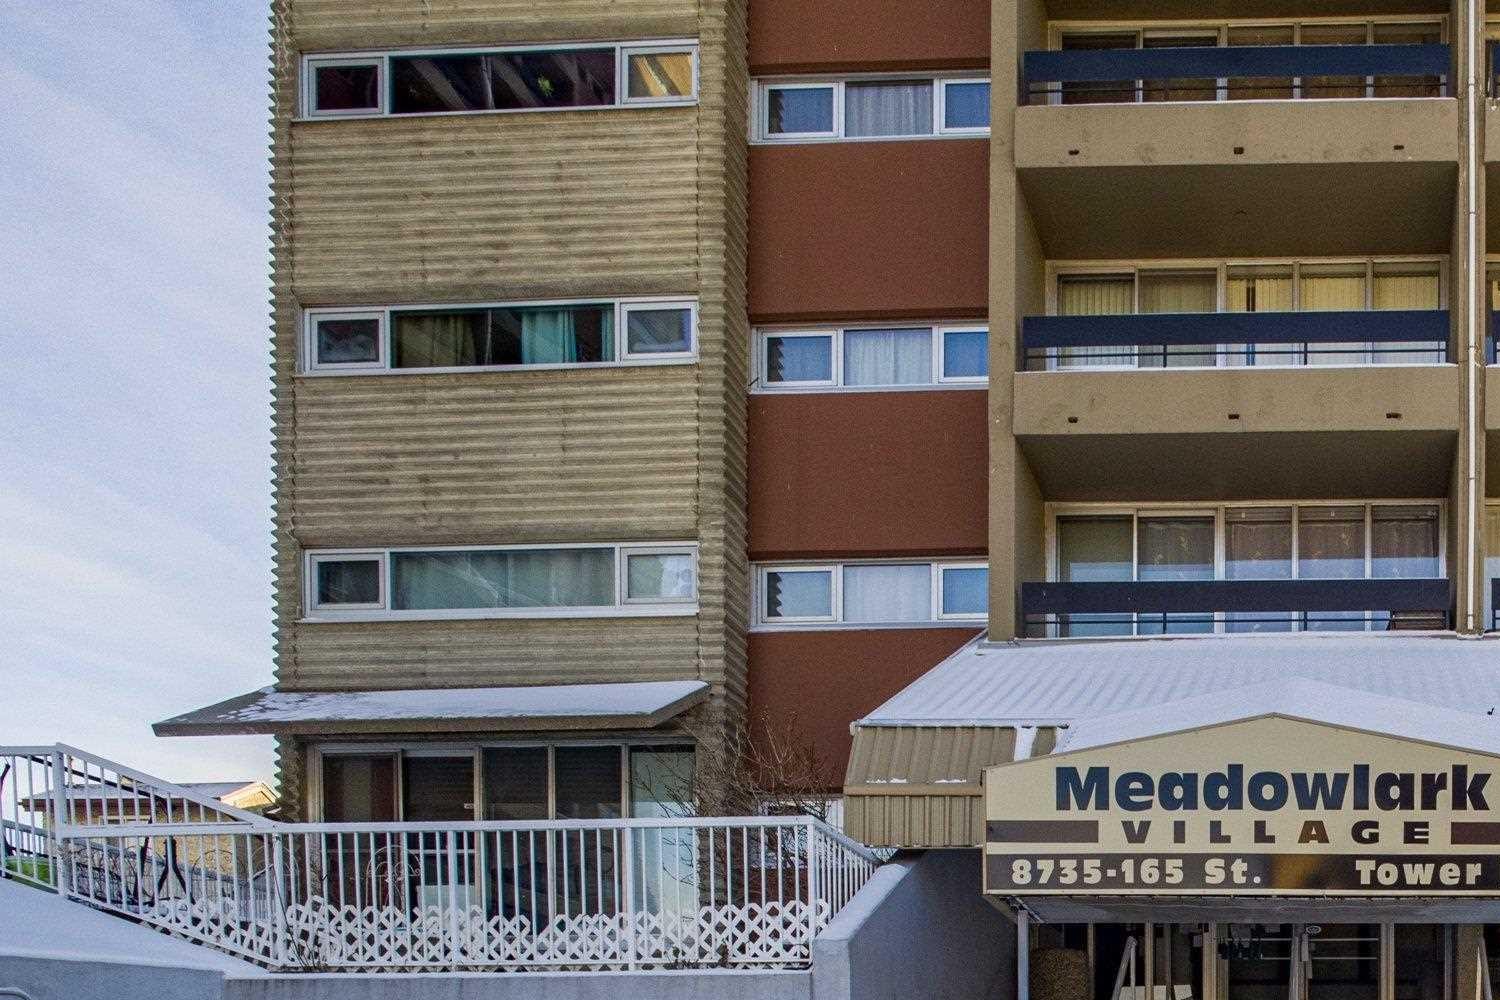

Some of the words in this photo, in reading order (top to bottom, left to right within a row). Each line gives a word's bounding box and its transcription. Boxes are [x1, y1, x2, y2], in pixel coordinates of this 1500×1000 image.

[1055, 764, 1491, 812] Meadowlark
[1121, 820, 1430, 845] VILLAGE
[1011, 858, 1184, 885] 8735-165
[1204, 857, 1262, 885] St.
[1355, 859, 1482, 886] Tower
